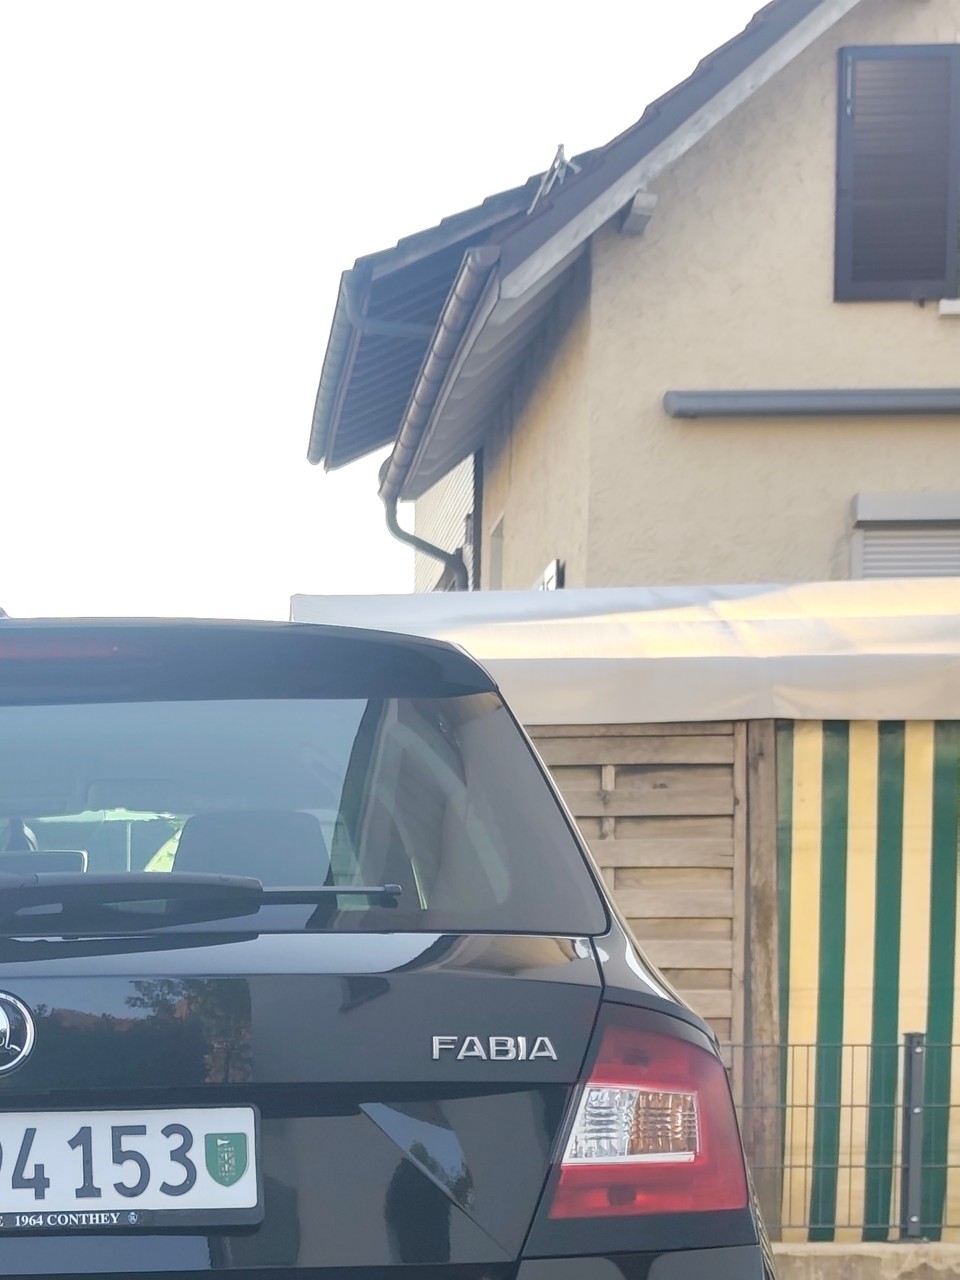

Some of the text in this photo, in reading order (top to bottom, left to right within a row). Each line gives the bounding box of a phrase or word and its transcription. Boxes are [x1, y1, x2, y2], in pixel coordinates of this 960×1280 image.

[431, 1035, 558, 1061] FABIA
[14, 1214, 44, 1227] 1964
[46, 1211, 121, 1226] CONTHEY
